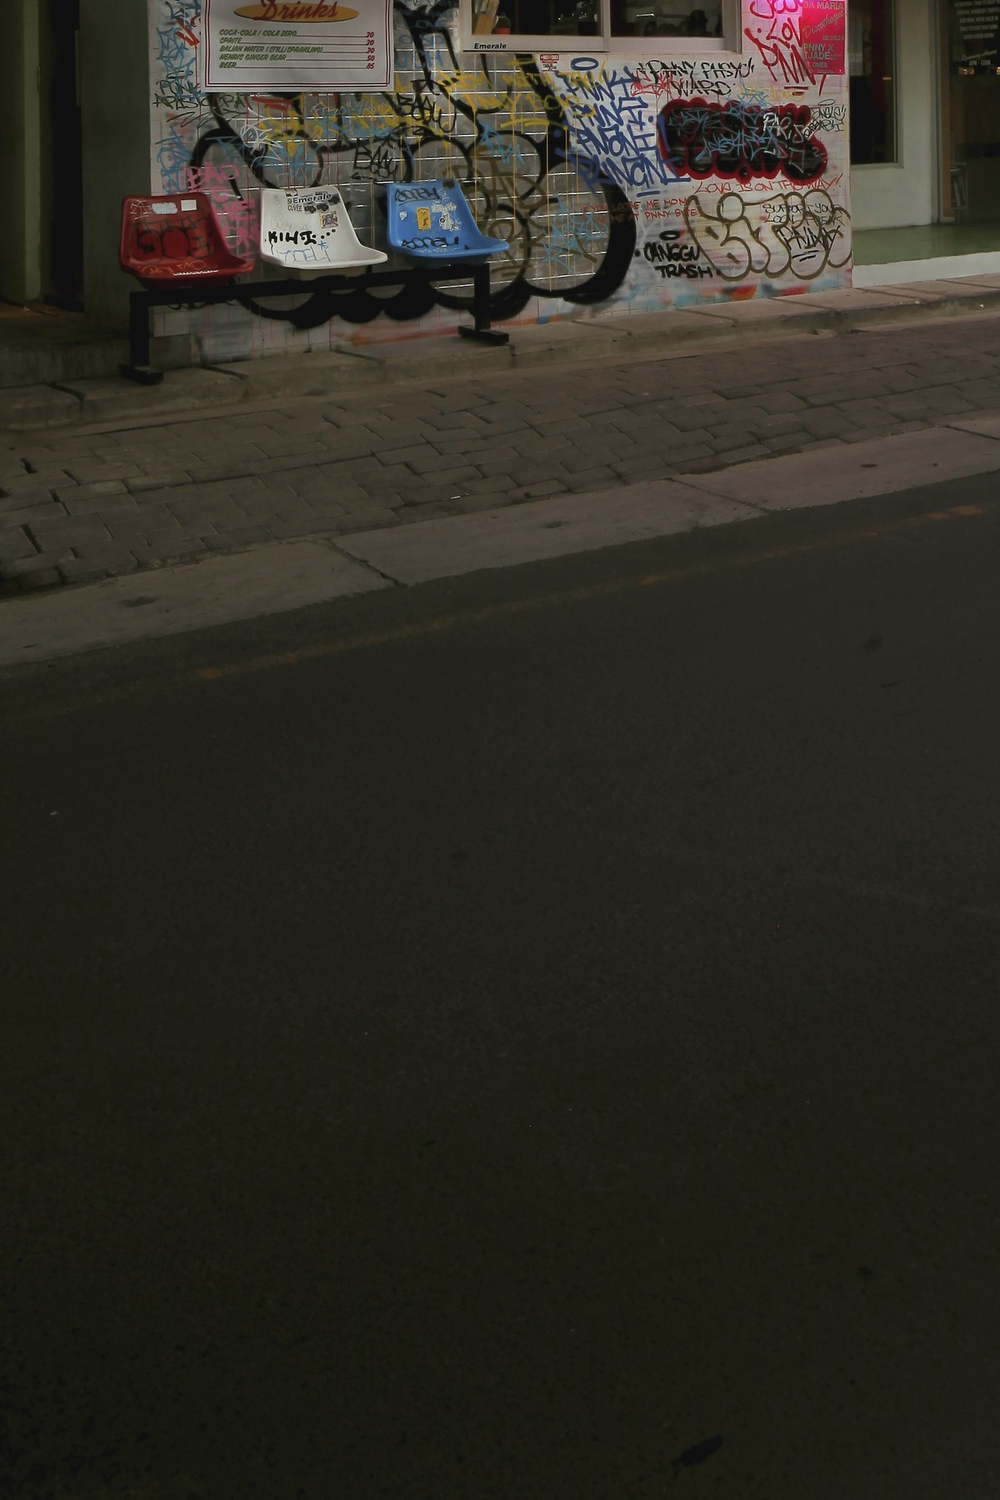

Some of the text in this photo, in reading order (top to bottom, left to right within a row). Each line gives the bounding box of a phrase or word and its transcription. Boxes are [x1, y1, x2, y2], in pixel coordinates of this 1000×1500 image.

[803, 1, 844, 9] DA MARIA
[220, 29, 257, 37] COCA-COLA
[803, 43, 834, 52] PNNY X
[738, 181, 752, 193] IS
[754, 181, 773, 192] ON
[646, 200, 659, 208] ME
[645, 210, 670, 219] PNNY
[643, 242, 700, 263] CANGGU
[655, 263, 713, 279] TRASH
